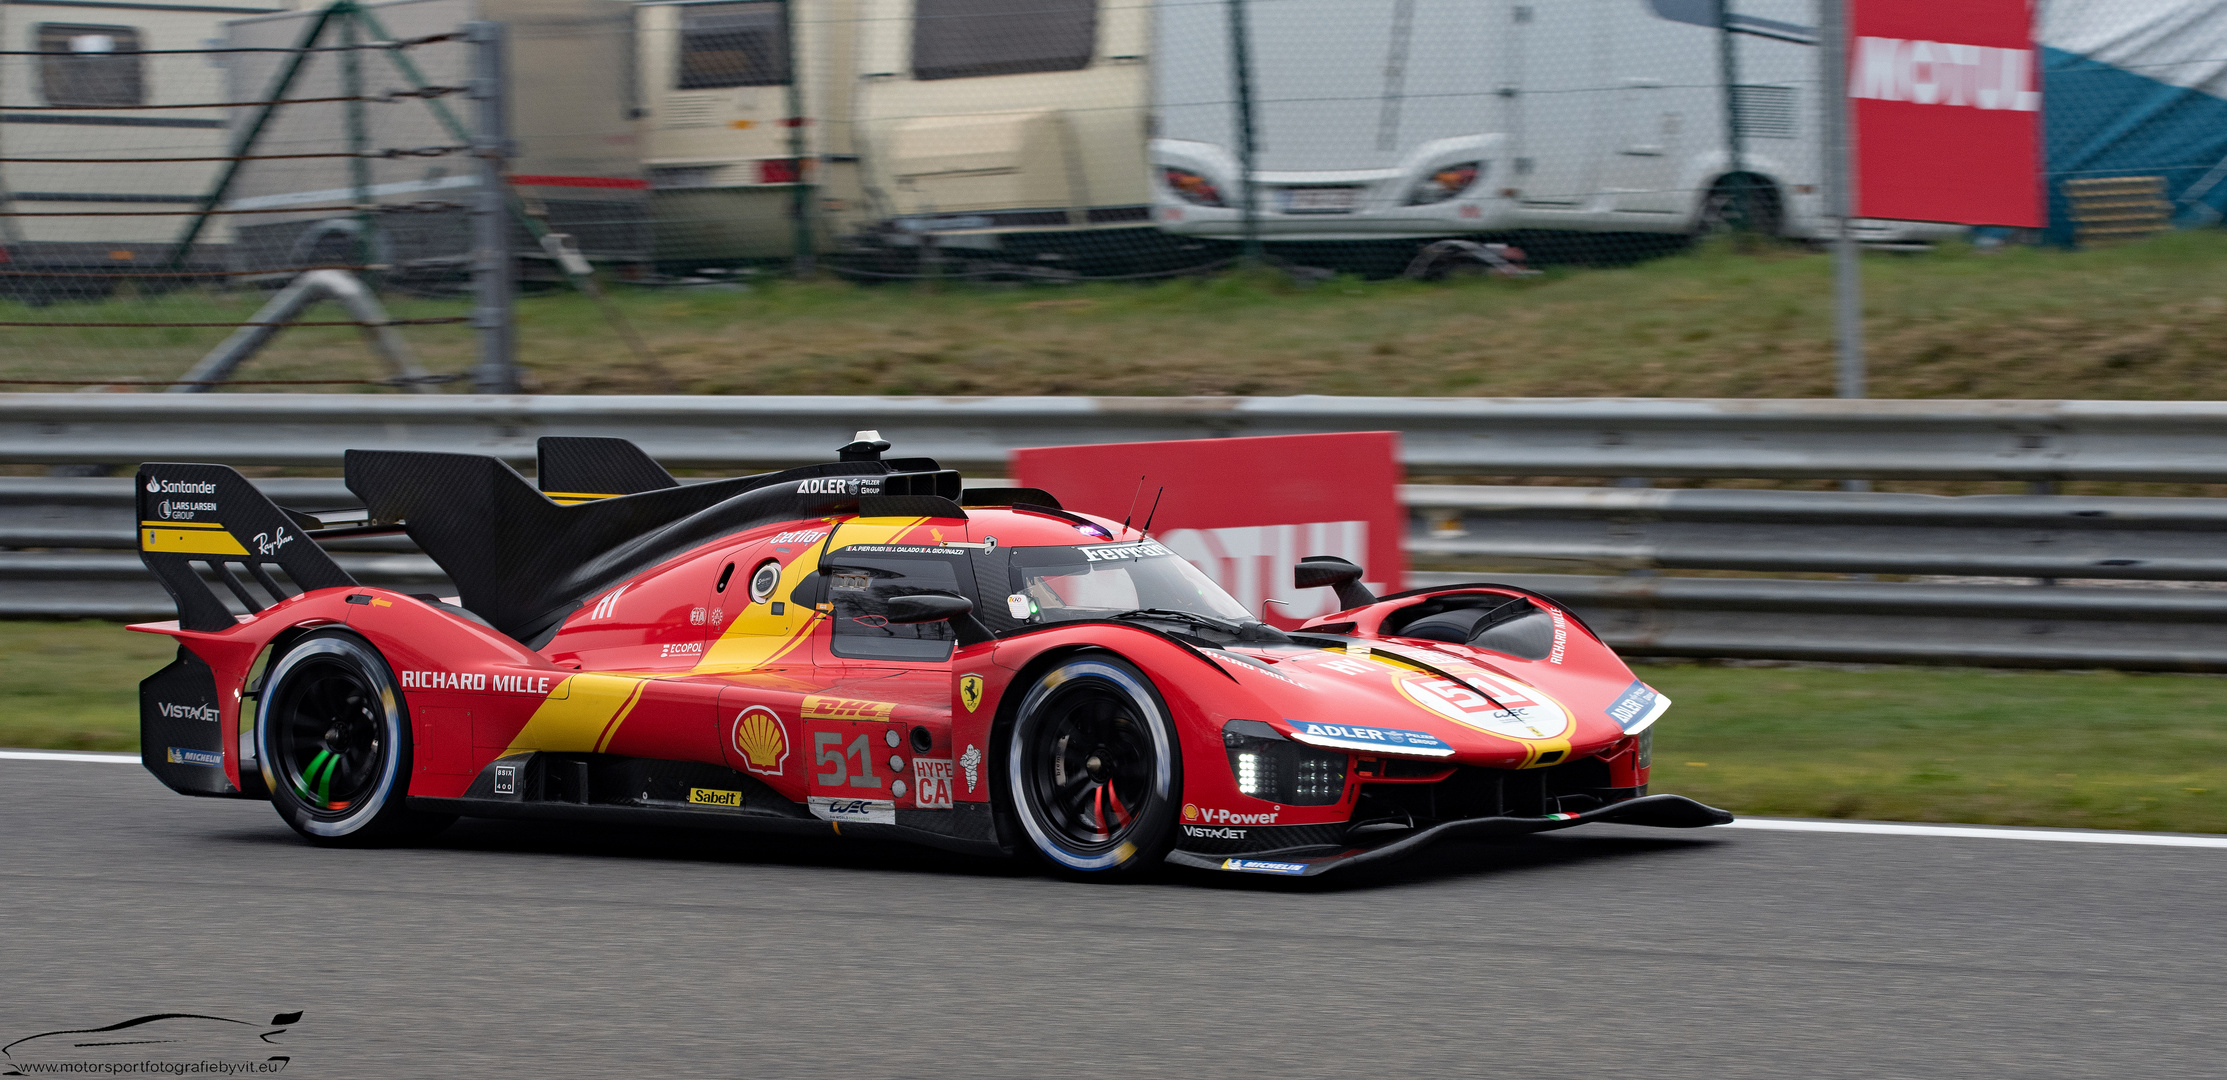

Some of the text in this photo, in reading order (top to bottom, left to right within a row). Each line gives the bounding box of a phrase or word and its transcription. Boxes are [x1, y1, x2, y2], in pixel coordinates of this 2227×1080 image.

[1847, 35, 2042, 112] MOTUL
[161, 480, 216, 494] Santander
[796, 478, 847, 494] ADLER
[172, 501, 217, 511] LARS LARSEN
[172, 511, 194, 520] GROUP
[252, 526, 293, 556] Ray-Ban
[690, 610, 705, 622] FIA
[670, 643, 702, 653] ECOPOL
[1549, 629, 1567, 665] RICHARD
[401, 670, 550, 694] RICHARD MILLE
[1419, 677, 1530, 709] 51
[813, 699, 880, 717] DHL
[1306, 724, 1385, 741] ADLER
[1408, 737, 1439, 746] GROUP
[184, 752, 221, 764] MICHELIN
[814, 731, 882, 789] 51
[694, 790, 737, 805] Sabelt
[829, 800, 872, 814] WEC
[1200, 808, 1279, 825] V-Power
[1243, 861, 1304, 871] MICHELIN
